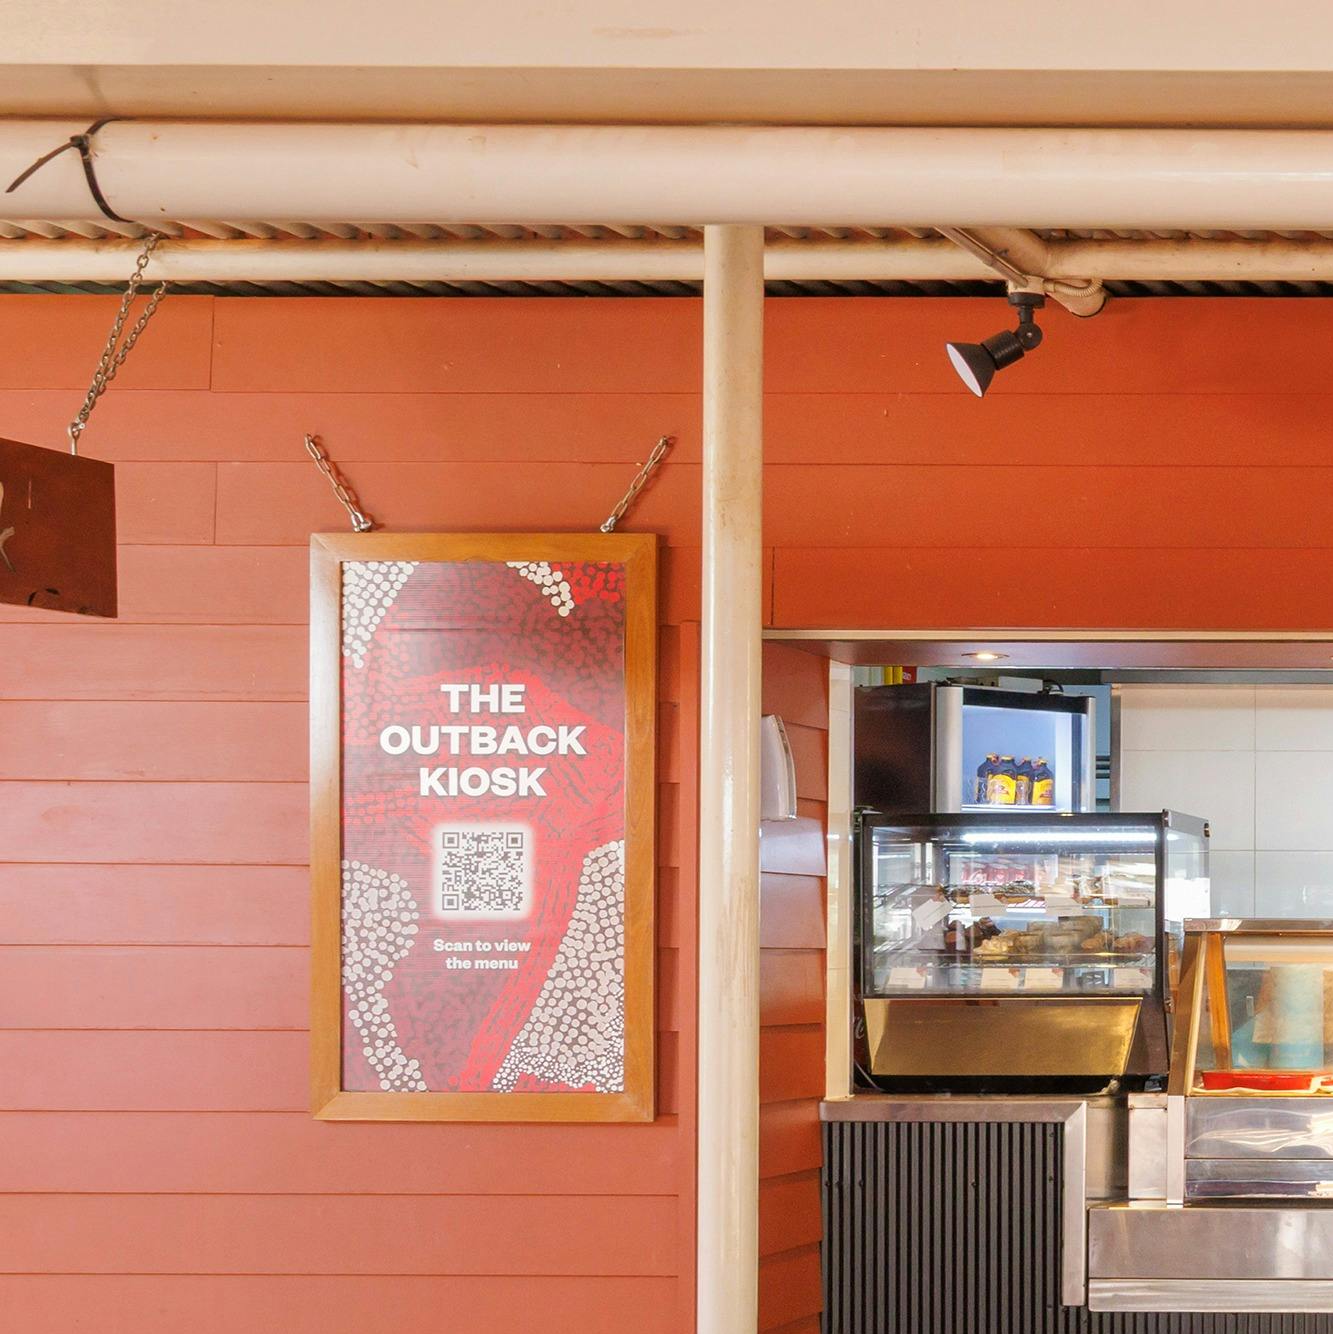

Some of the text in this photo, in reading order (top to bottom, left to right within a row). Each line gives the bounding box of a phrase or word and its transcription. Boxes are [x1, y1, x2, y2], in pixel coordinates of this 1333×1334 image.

[440, 684, 525, 713] THE
[379, 725, 587, 755] OUTBACK
[419, 767, 548, 796] KIOSK
[433, 938, 532, 952] Scan to view
[445, 957, 519, 969] the menu
